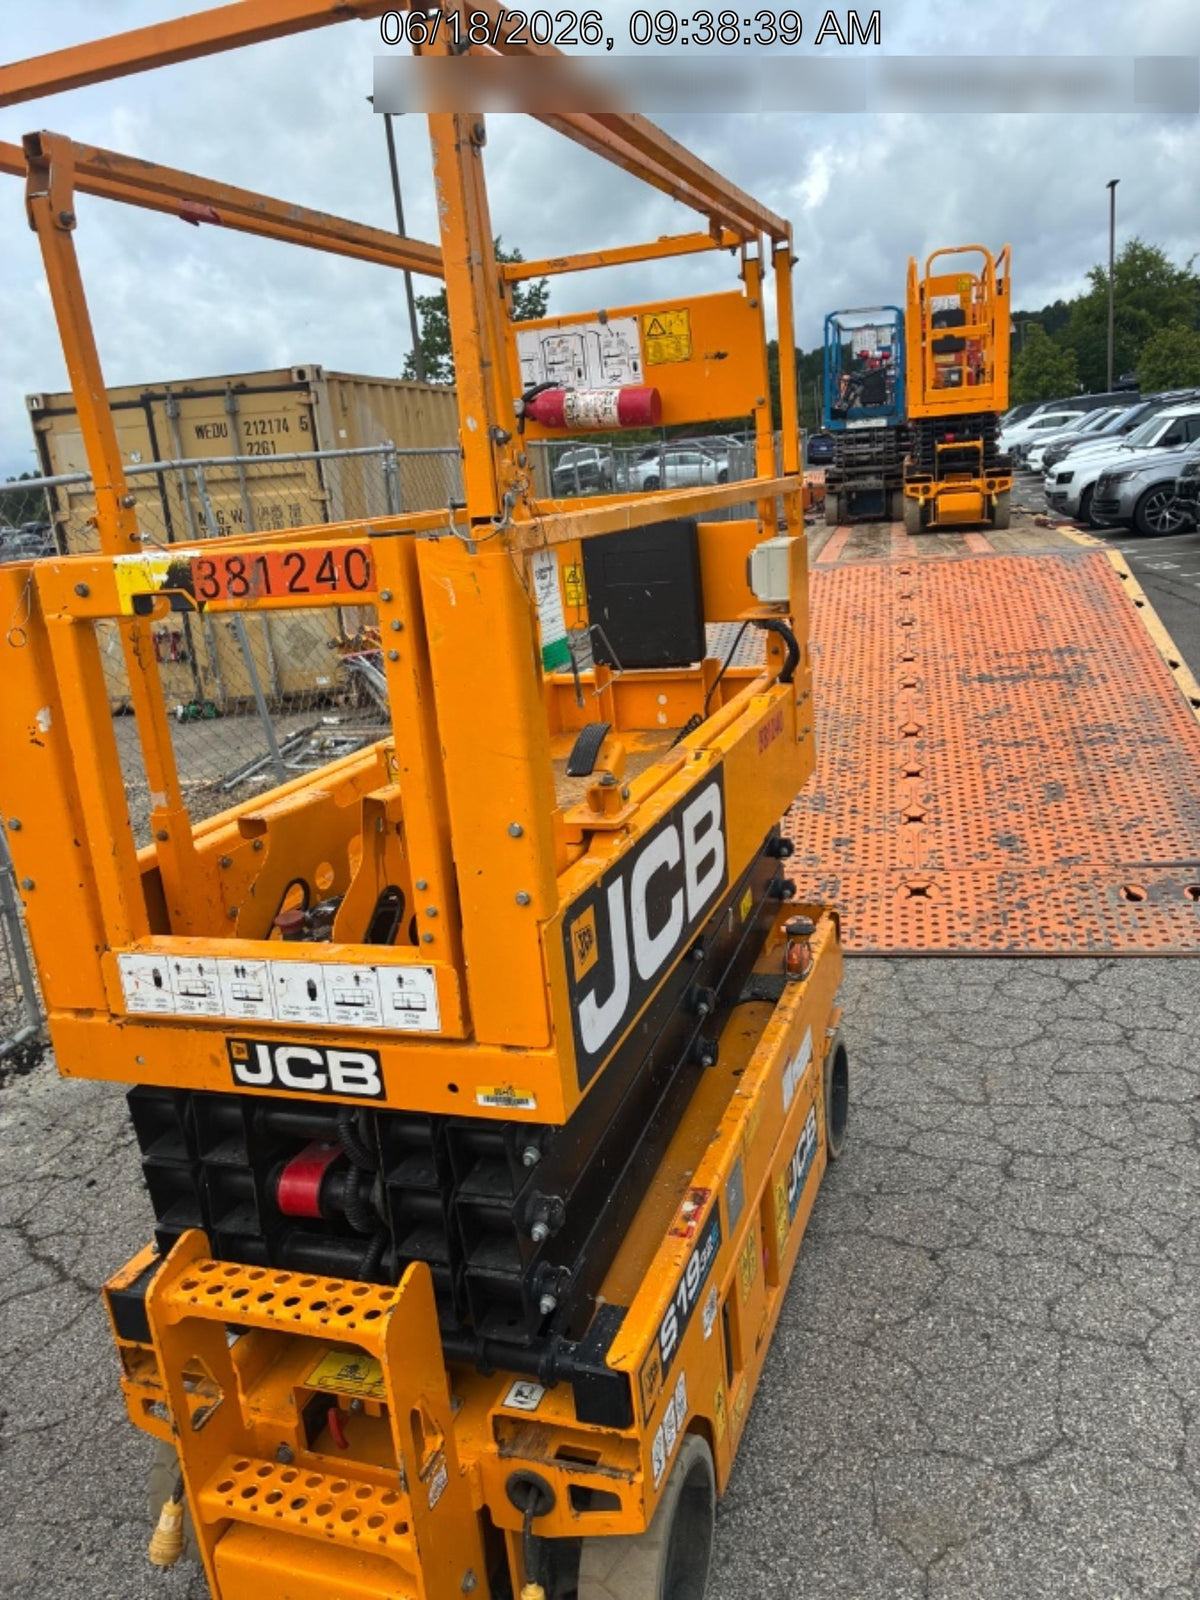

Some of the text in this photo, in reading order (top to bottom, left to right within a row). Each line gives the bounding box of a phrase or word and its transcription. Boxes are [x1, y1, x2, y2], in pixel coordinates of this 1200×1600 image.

[194, 415, 310, 440] WEDU 212174 5
[197, 548, 371, 599] 381240
[579, 782, 725, 1055] JCB
[233, 1043, 382, 1097] JCB
[788, 1104, 817, 1204] JCB
